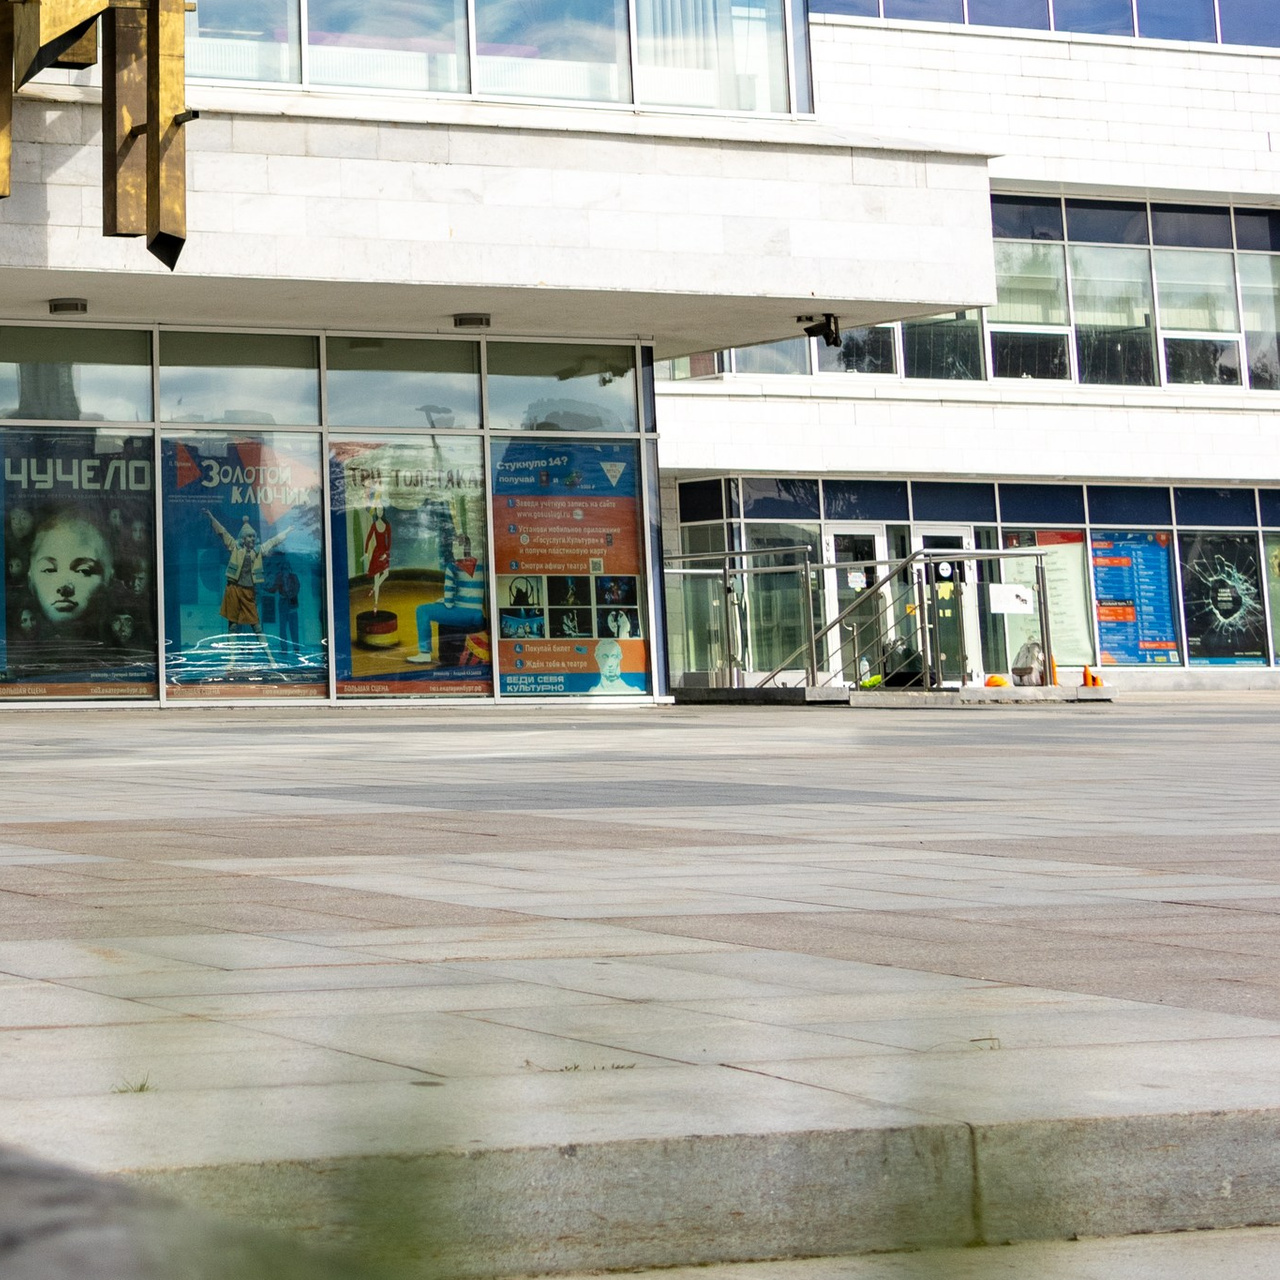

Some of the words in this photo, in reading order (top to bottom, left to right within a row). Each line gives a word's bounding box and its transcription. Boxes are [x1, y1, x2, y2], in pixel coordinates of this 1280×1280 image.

[496, 460, 547, 471] Стукнуло
[548, 456, 568, 466] 14?
[4, 457, 152, 491] ЧУЧЕЛО
[390, 468, 480, 490] ТОЛСТЯКА
[498, 475, 536, 485] получай
[599, 499, 616, 508] сайте
[525, 644, 552, 654] Покупай
[552, 644, 571, 652] билет
[506, 676, 535, 684] ВЕДИ
[537, 675, 565, 683] СЕБЯ
[27, 687, 47, 695] СЦЕНА
[370, 685, 389, 693] СЦЕНА
[506, 684, 565, 692] КУЛЬТУРНО
